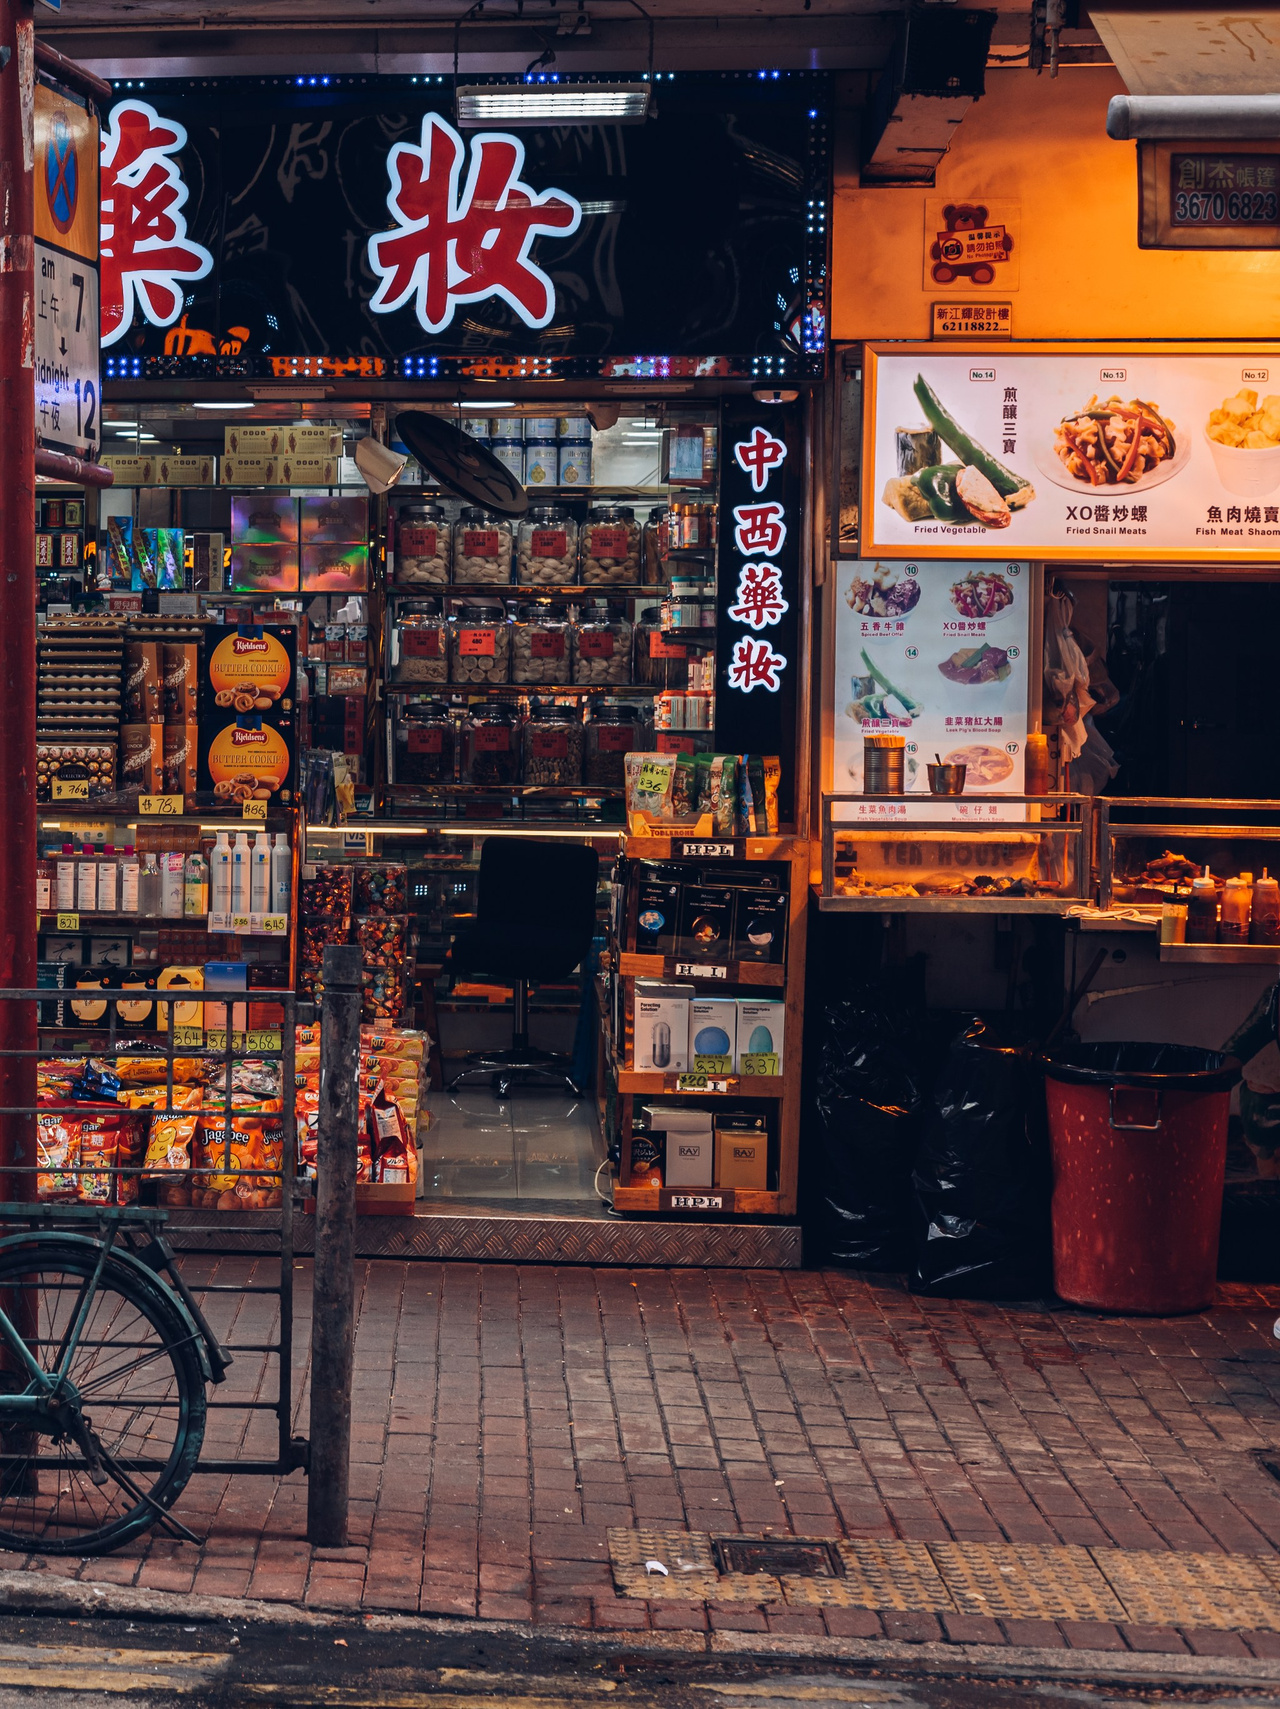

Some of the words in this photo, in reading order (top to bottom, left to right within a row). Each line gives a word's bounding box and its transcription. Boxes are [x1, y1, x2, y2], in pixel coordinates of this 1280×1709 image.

[1175, 191, 1226, 221] 3670
[1227, 191, 1278, 221] 6823
[41, 256, 55, 280] am
[38, 289, 59, 324] 上午
[72, 273, 84, 333] 7
[972, 371, 993, 379] No.14
[39, 395, 61, 432] 午夜
[74, 378, 96, 441] 12
[1002, 386, 1018, 455] 煎釀三寶
[1066, 505, 1148, 524] XO醬炒螺
[1206, 505, 1280, 524] 魚肉燒賣
[914, 525, 938, 535] Fried
[940, 525, 987, 536] Vegetable
[1066, 526, 1091, 536] Fried
[1093, 526, 1117, 536] Snail
[1119, 526, 1147, 536] Meats
[1195, 527, 1217, 537] Fish
[1220, 527, 1244, 537] Meat
[728, 426, 789, 693] 中西藥妝
[906, 566, 917, 574] 10
[1008, 565, 1019, 574] 13
[236, 640, 266, 651] Kjeldsens
[213, 664, 247, 673] BUTTER
[250, 664, 287, 673] COOKIES
[235, 731, 266, 743] Kjeldsens
[906, 744, 916, 752] 16
[1007, 744, 1017, 752] 17
[212, 755, 246, 764] BUTTER
[249, 755, 287, 764] COOKIES
[650, 829, 695, 837] TOBLERONE
[685, 844, 731, 855] HPL
[299, 1031, 314, 1041] RITZ
[371, 1038, 385, 1047] RITZ
[365, 1057, 379, 1067] RITZ
[38, 1115, 62, 1126] ugar
[681, 1147, 699, 1156] RAY
[735, 1149, 754, 1158] RAY
[674, 1196, 719, 1208] HPL
